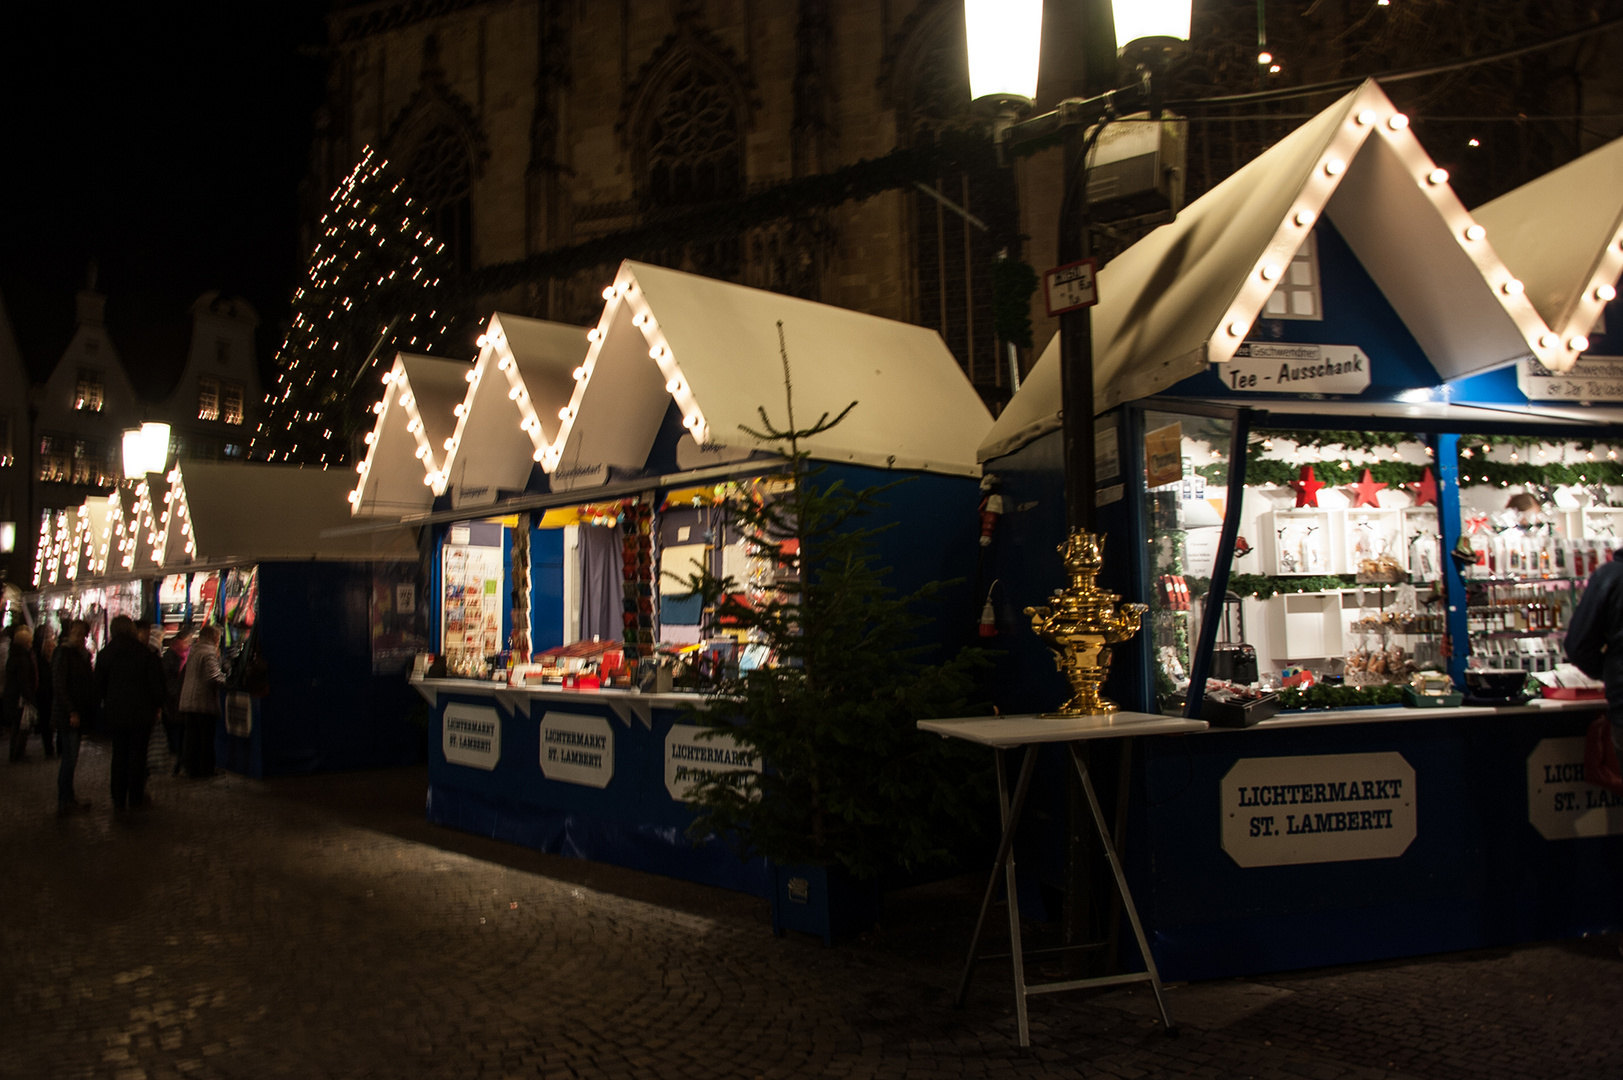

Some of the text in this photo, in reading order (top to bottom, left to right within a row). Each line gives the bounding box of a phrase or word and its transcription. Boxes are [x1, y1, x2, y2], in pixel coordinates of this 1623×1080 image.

[1229, 369, 1257, 389] Tee
[1277, 353, 1363, 384] Ausschank
[447, 717, 495, 737] LICHTERMARKT
[459, 735, 491, 753] LAMBERTI
[545, 728, 607, 750] LICHTERMARKT
[548, 747, 602, 769] ST. LAMBERTI
[1543, 763, 1585, 784] LICH
[1238, 779, 1402, 808] LICHTERMARKT
[1554, 792, 1580, 811] ST.
[1250, 809, 1393, 837] ST. LAMBERTI
